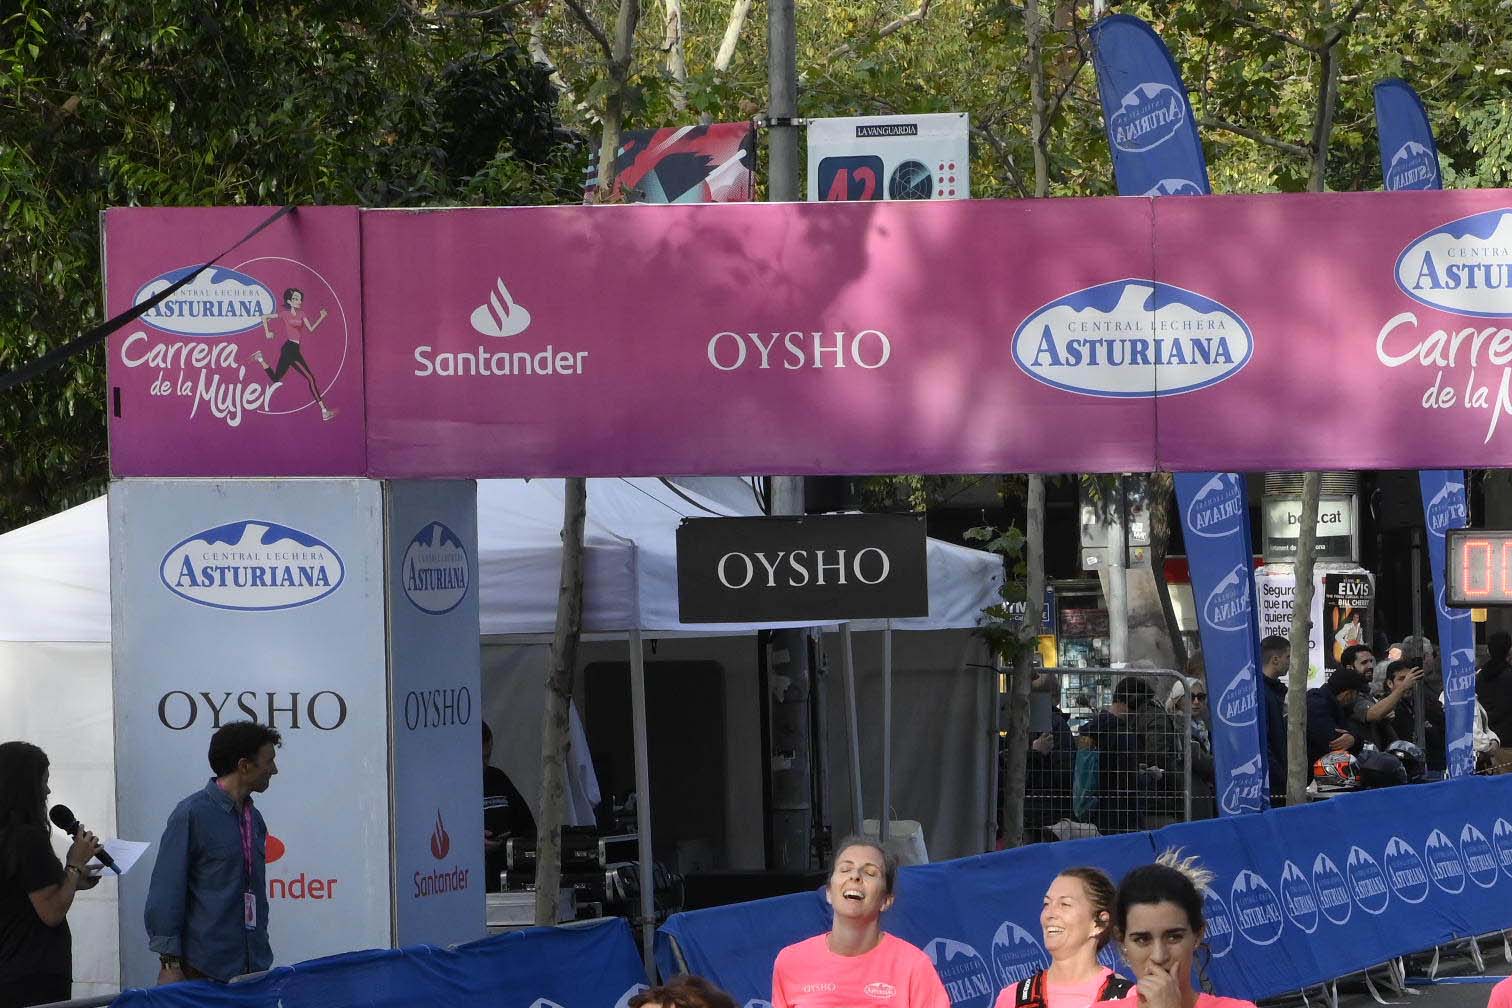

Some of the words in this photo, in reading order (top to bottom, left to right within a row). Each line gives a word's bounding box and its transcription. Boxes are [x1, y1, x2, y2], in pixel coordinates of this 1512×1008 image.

[867, 124, 916, 136] VANGUARDIA
[145, 290, 265, 318] ASTURIANA
[214, 289, 262, 298] LECHERA
[1067, 319, 1143, 332] CENTRAL
[1151, 318, 1227, 331] LECHERA
[121, 331, 240, 369] Carrera
[413, 344, 590, 378] Santander
[706, 328, 891, 372] OYSHO
[1029, 323, 1235, 369] ASTURIANA
[150, 371, 173, 396] de
[176, 370, 193, 396] la
[189, 364, 284, 428] Mujer
[1421, 370, 1457, 409] de
[1464, 367, 1490, 409] la
[175, 553, 332, 588] ASTURIANA
[202, 552, 260, 562] CENTRAL
[266, 551, 325, 562] LECHERA
[407, 555, 466, 592] ASTURIANA
[716, 546, 891, 590] OYSHO
[1263, 600, 1280, 612] que
[1338, 582, 1370, 596] ELVIS
[157, 689, 348, 732] OYSHO
[404, 686, 471, 732] OYSHO
[413, 868, 470, 900] Santander
